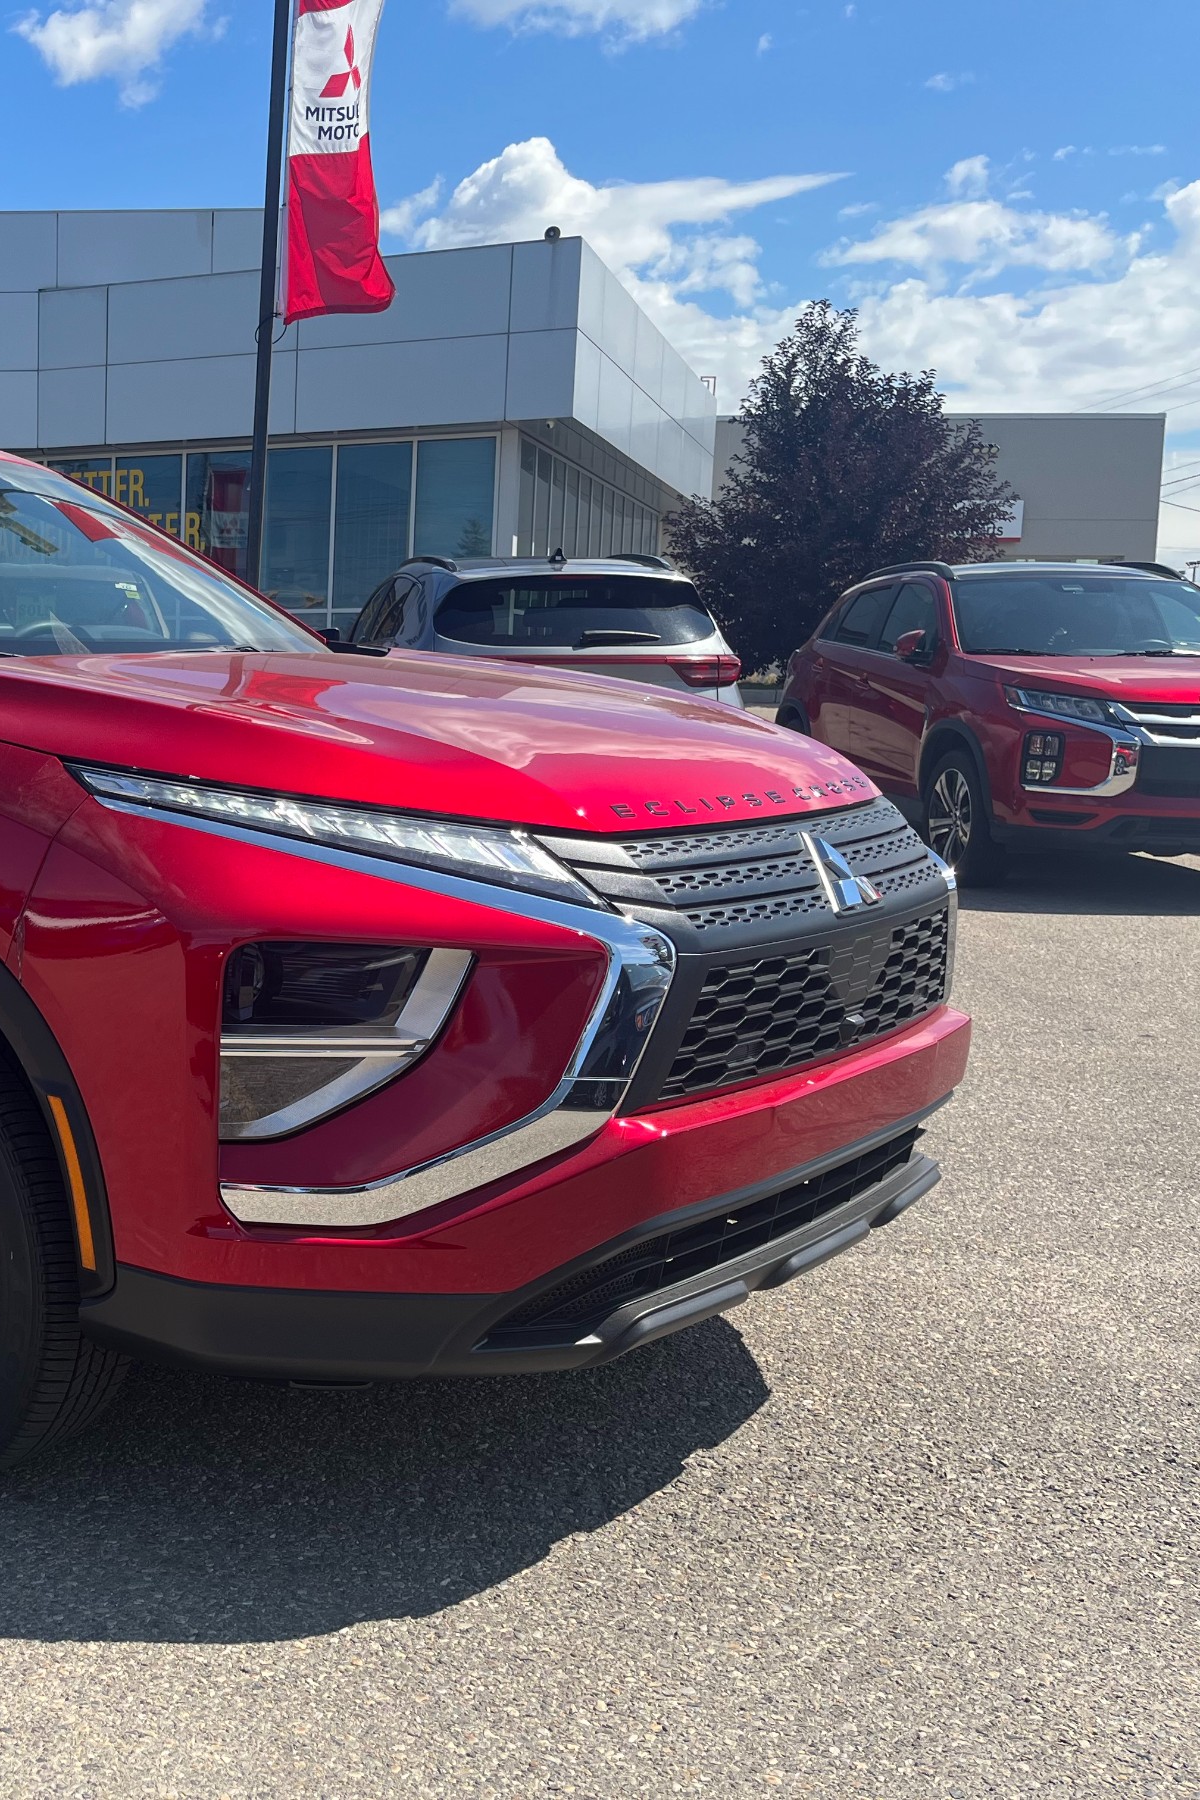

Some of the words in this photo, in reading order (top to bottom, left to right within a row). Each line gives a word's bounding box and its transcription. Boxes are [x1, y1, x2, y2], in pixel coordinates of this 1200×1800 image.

[305, 104, 359, 122] MITSU
[609, 789, 786, 819] ECLIPSE
[792, 775, 869, 801] CROSS
